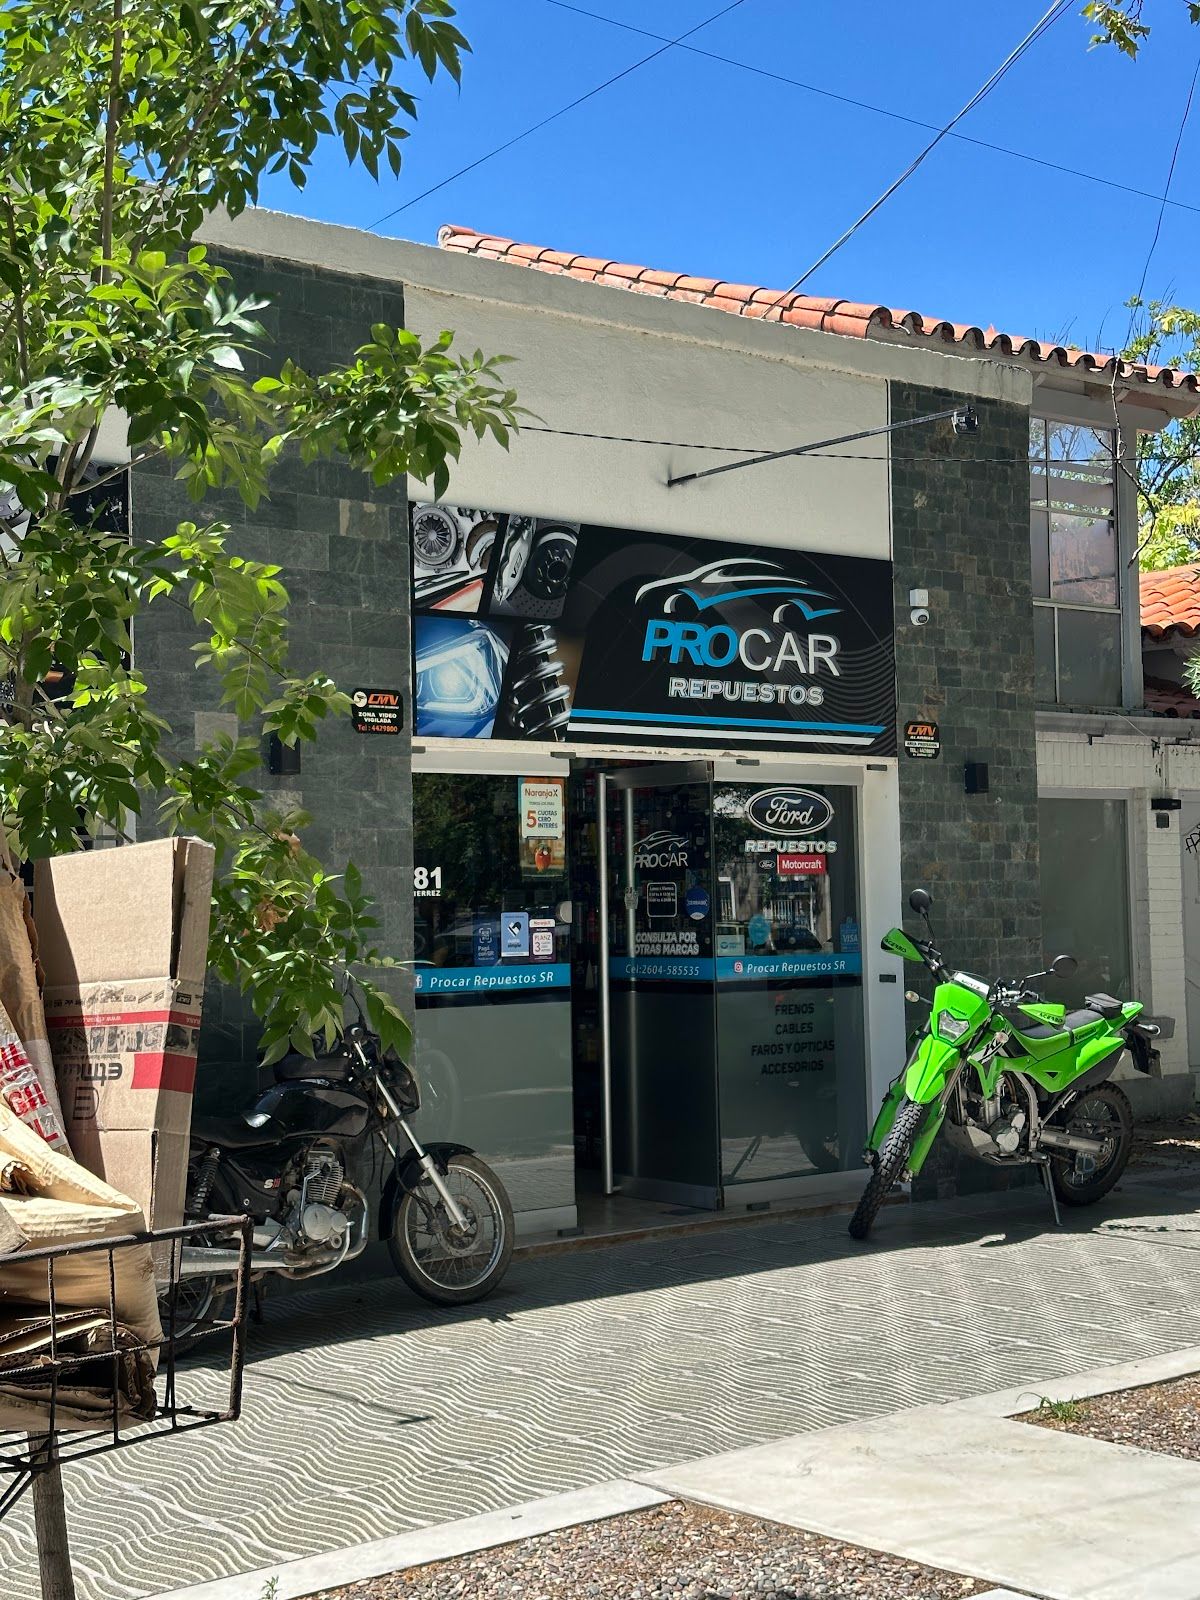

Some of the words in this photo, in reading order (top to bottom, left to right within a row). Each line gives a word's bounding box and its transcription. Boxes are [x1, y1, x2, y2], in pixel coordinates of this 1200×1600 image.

[642, 619, 840, 677] PROCAR
[669, 677, 825, 706] REPUESTOS
[765, 796, 814, 826] Ford
[526, 810, 537, 828] 5
[744, 840, 838, 853] REPUESTOS
[634, 852, 689, 869] PROCAR
[782, 859, 822, 870] Motorcraft
[636, 932, 678, 943] CONSULTA
[679, 932, 697, 943] POR
[842, 934, 858, 943] VISA
[535, 942, 541, 952] 3
[635, 944, 663, 954] OTRAS
[662, 944, 699, 955] MARCAS
[747, 962, 779, 973] Procar
[781, 961, 831, 973] Repuestos
[834, 960, 846, 970] SR
[430, 976, 472, 988] Procar
[474, 973, 536, 988] Repuestos
[540, 972, 554, 983] SR
[775, 1002, 815, 1016] FRENOS
[776, 1022, 814, 1035] CABLES
[752, 1043, 784, 1056] FAROS
[785, 1042, 792, 1053] Y
[794, 1040, 835, 1053] OPTICAS
[761, 1060, 824, 1074] ACCESORIOS
